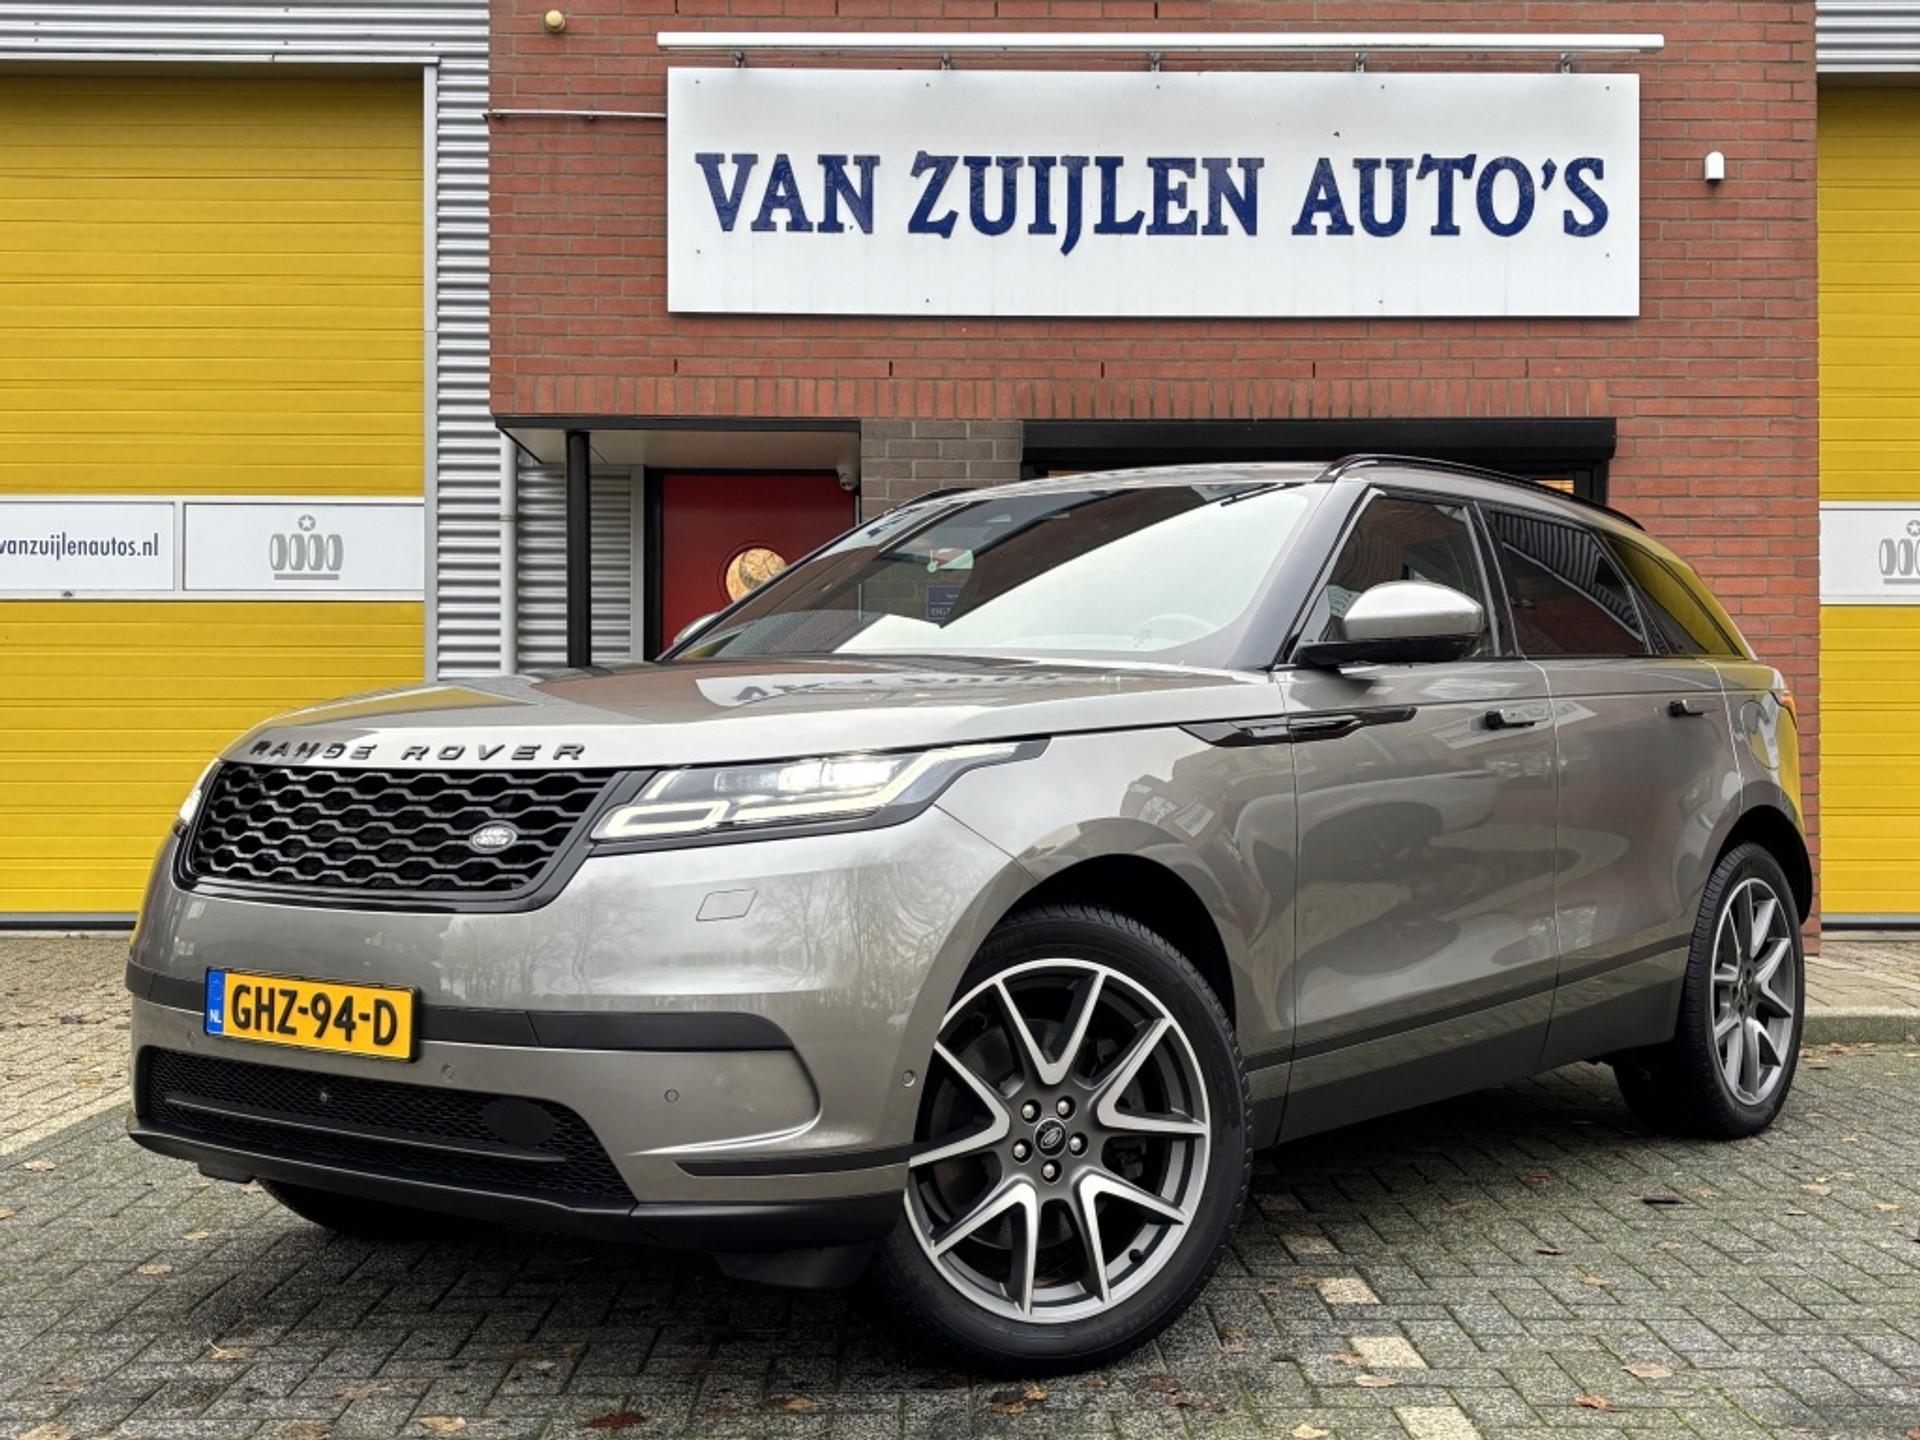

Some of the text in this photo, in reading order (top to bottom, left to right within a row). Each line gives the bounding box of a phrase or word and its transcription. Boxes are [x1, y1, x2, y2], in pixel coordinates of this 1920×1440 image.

[695, 150, 1609, 256] VAN ZUIJLEN AUTO'S
[250, 740, 585, 761] RANGE ROVER
[209, 1009, 222, 1024] NL
[231, 984, 398, 1046] GHZ-94-D
